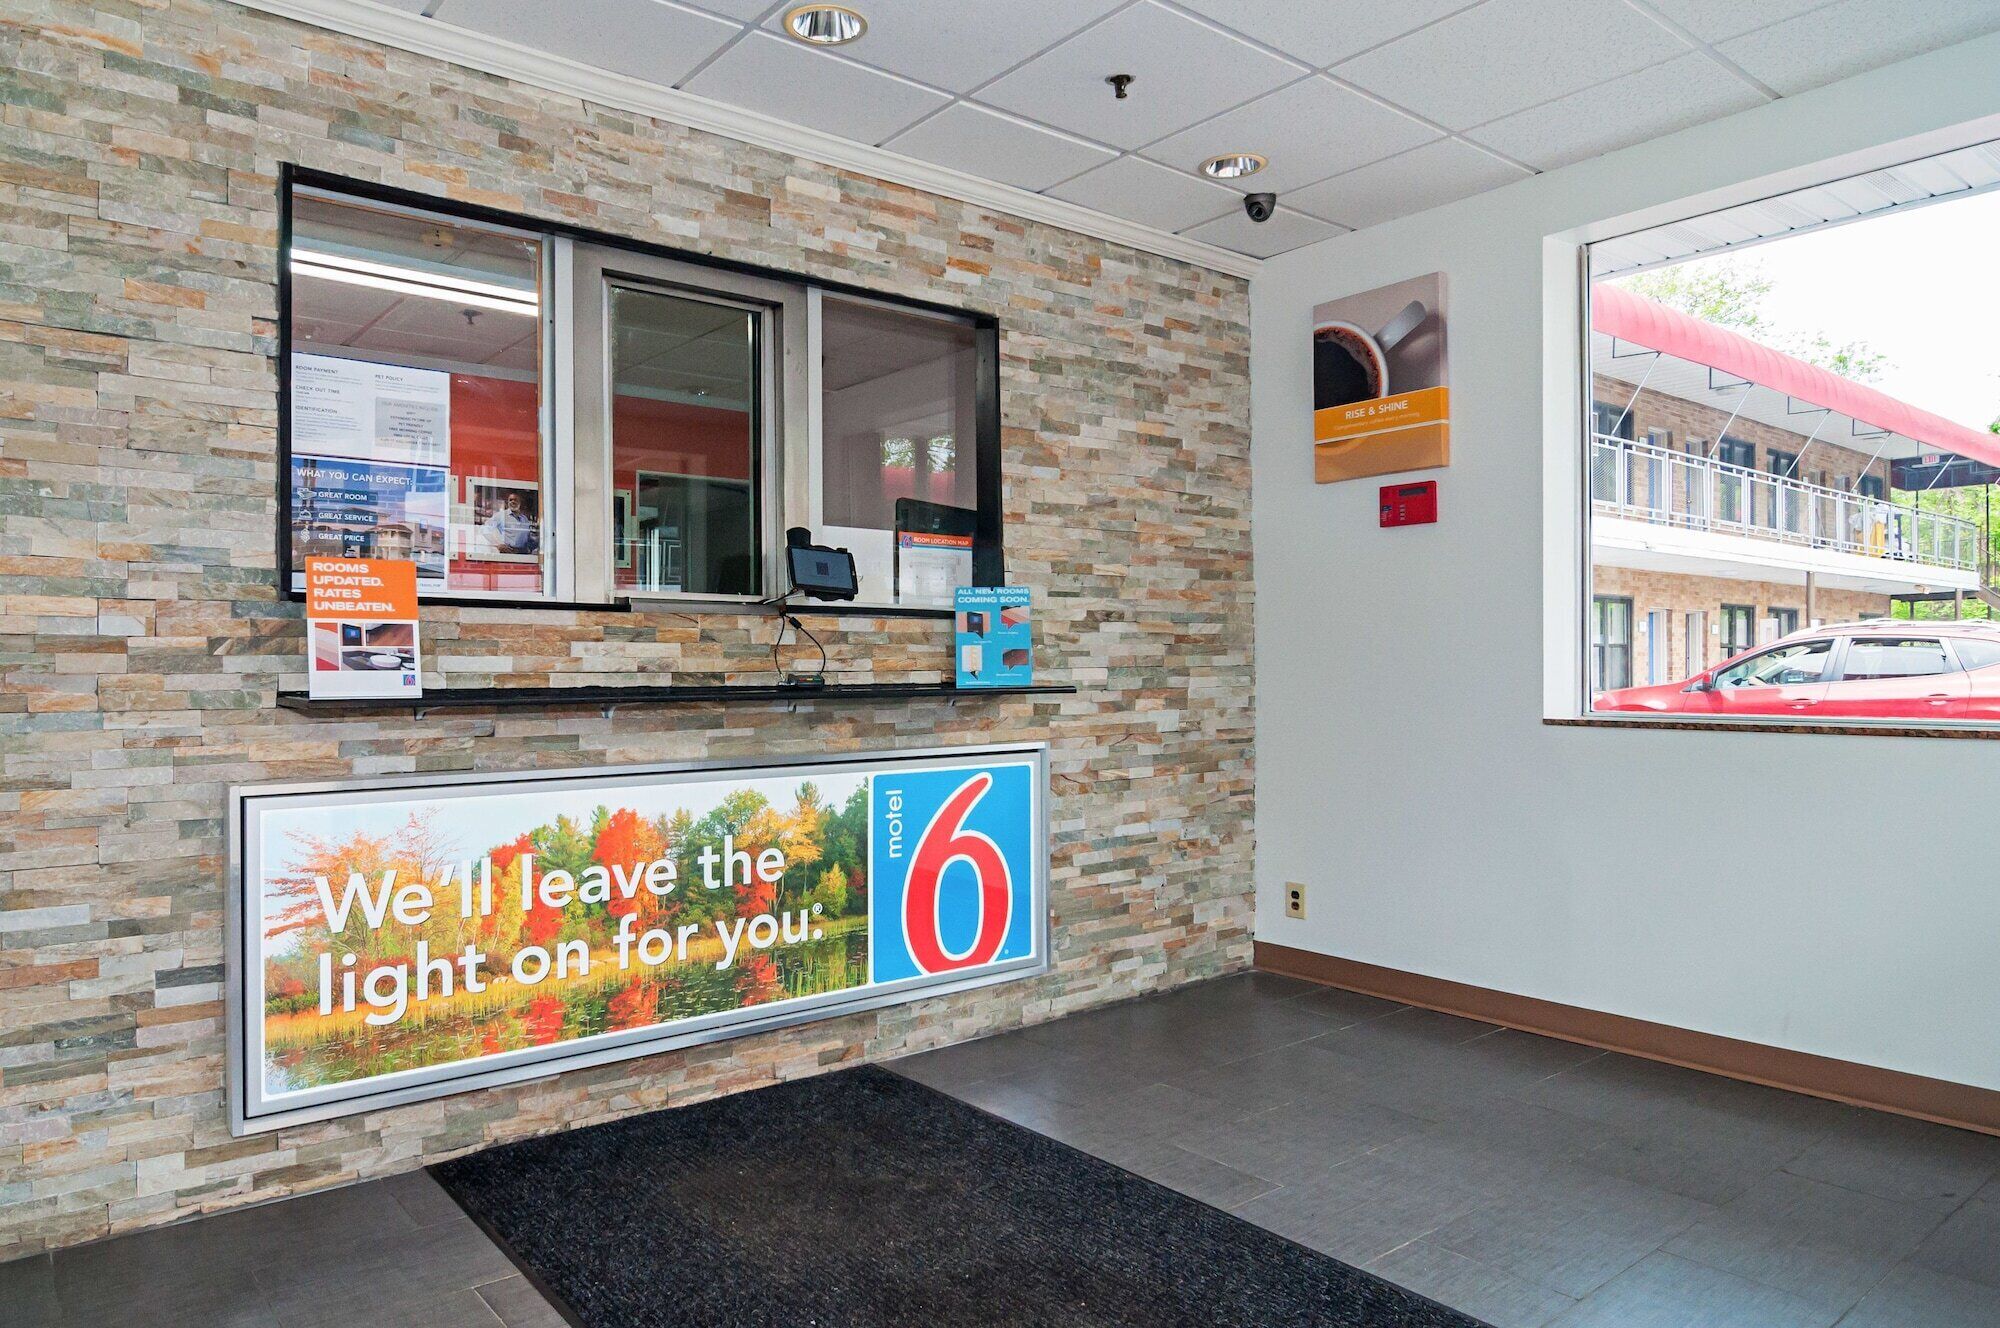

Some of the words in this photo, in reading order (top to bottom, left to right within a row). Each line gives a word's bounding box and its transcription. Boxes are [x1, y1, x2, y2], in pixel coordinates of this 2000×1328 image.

[1345, 408, 1366, 420] RISE
[1368, 406, 1376, 416] &
[1378, 400, 1409, 414] SHINE
[297, 468, 325, 478] WHAT
[329, 470, 349, 480] YOU
[352, 473, 372, 482] CAN
[376, 475, 414, 486] EXPECT:
[318, 491, 342, 499] GREAT
[344, 493, 367, 501] ROOM
[318, 512, 342, 520] GREAT
[344, 514, 373, 522] SERVICE
[318, 533, 342, 541] GREAT
[344, 534, 365, 542] PRICE
[312, 562, 369, 574] ROOMS
[313, 575, 384, 587] UPDATED.
[313, 588, 362, 599] RATES
[957, 596, 997, 604] COMING
[314, 601, 396, 612] UNBEATEN.
[885, 789, 903, 859] motel
[901, 771, 1013, 975] 6
[314, 856, 492, 934] We'll
[520, 852, 678, 912] leave
[697, 834, 785, 890] the
[318, 940, 487, 1026] light
[511, 937, 590, 985] on
[612, 912, 699, 970] for
